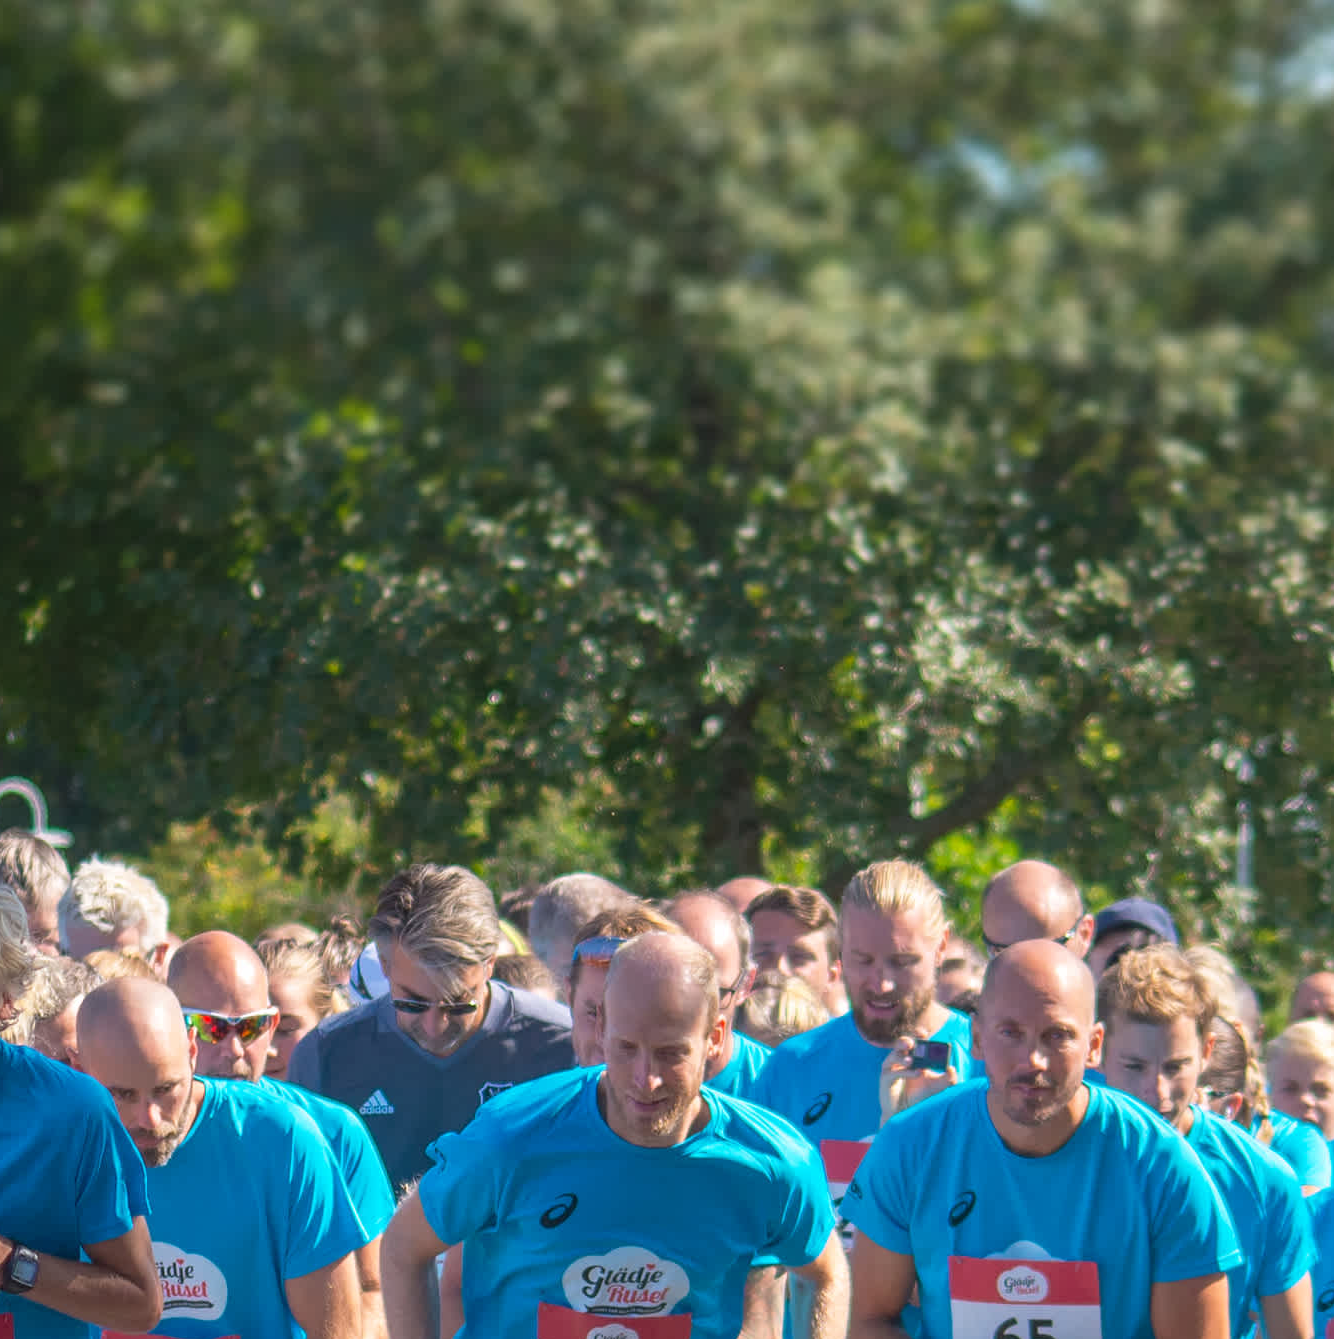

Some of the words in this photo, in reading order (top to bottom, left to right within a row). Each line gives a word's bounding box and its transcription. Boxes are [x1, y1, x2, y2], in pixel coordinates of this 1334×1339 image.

[359, 1104, 395, 1115] adidas
[156, 1262, 195, 1284] ädje
[582, 1265, 664, 1298] Glädje
[607, 1284, 670, 1304] Ruset
